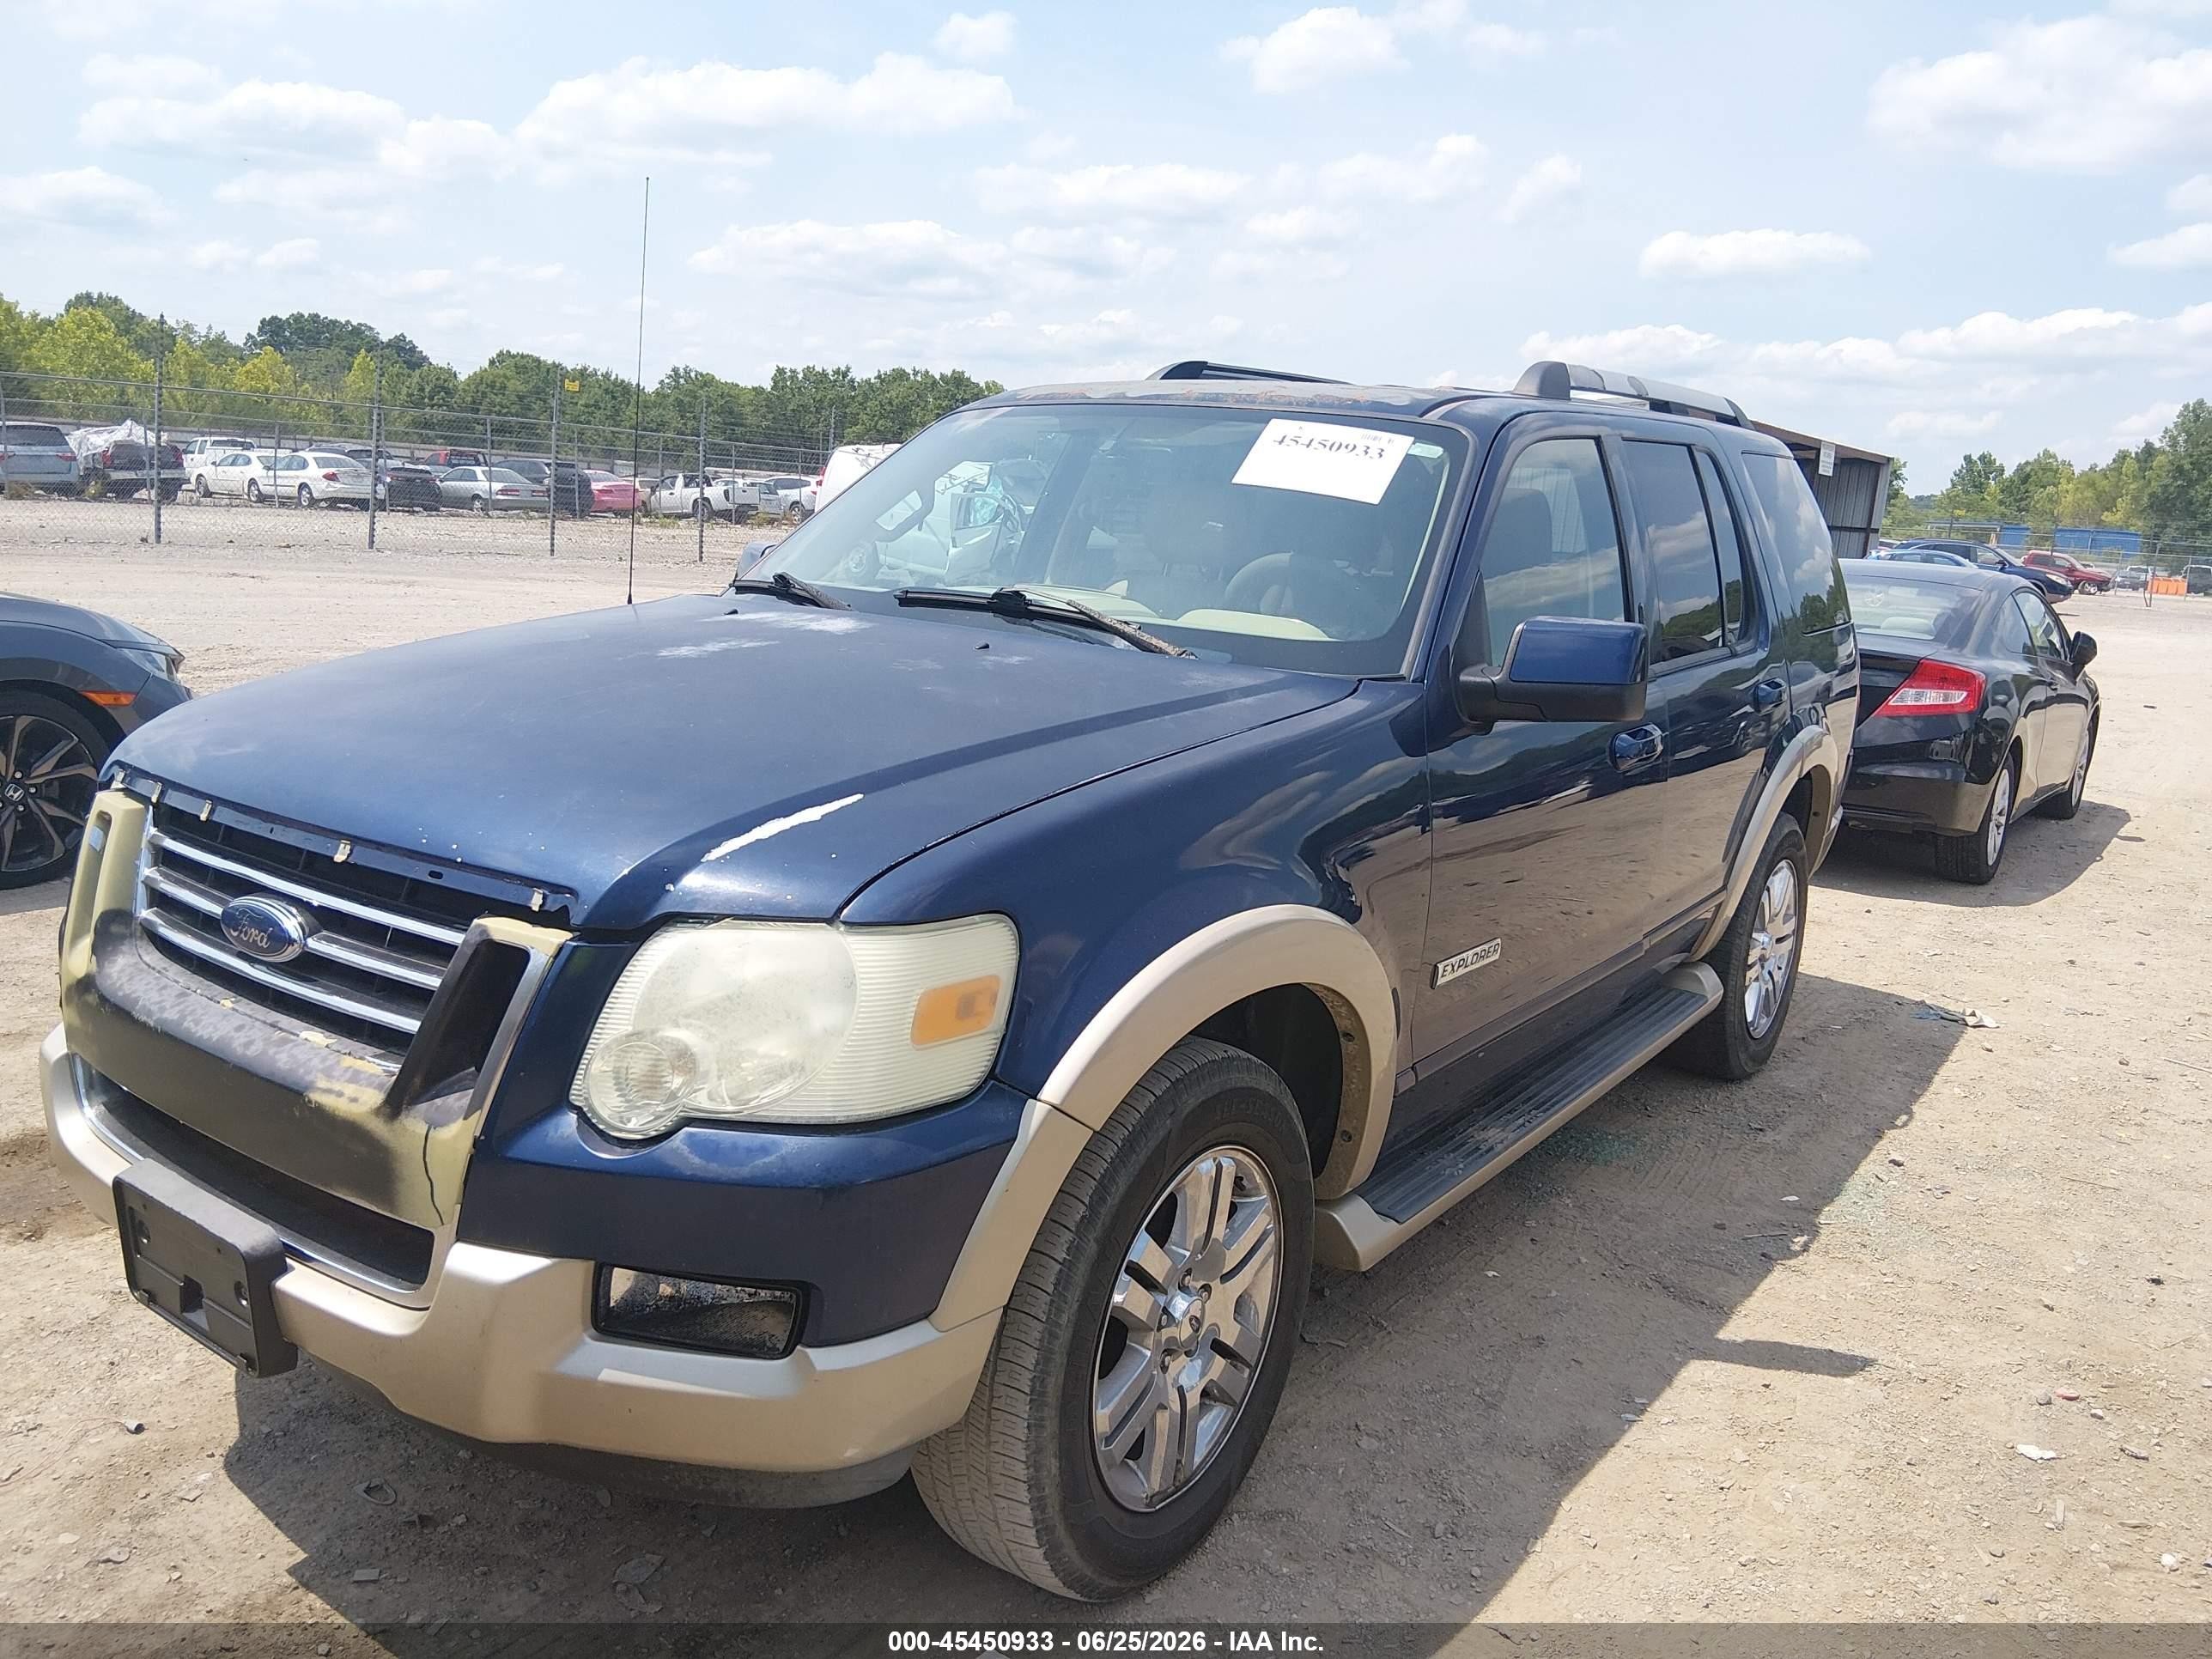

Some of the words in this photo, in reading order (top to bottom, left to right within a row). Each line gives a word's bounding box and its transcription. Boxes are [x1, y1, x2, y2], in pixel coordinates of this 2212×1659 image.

[1273, 434, 1386, 459] 45450933
[230, 907, 272, 949] Ford
[1440, 943, 1500, 979] EXPLORER
